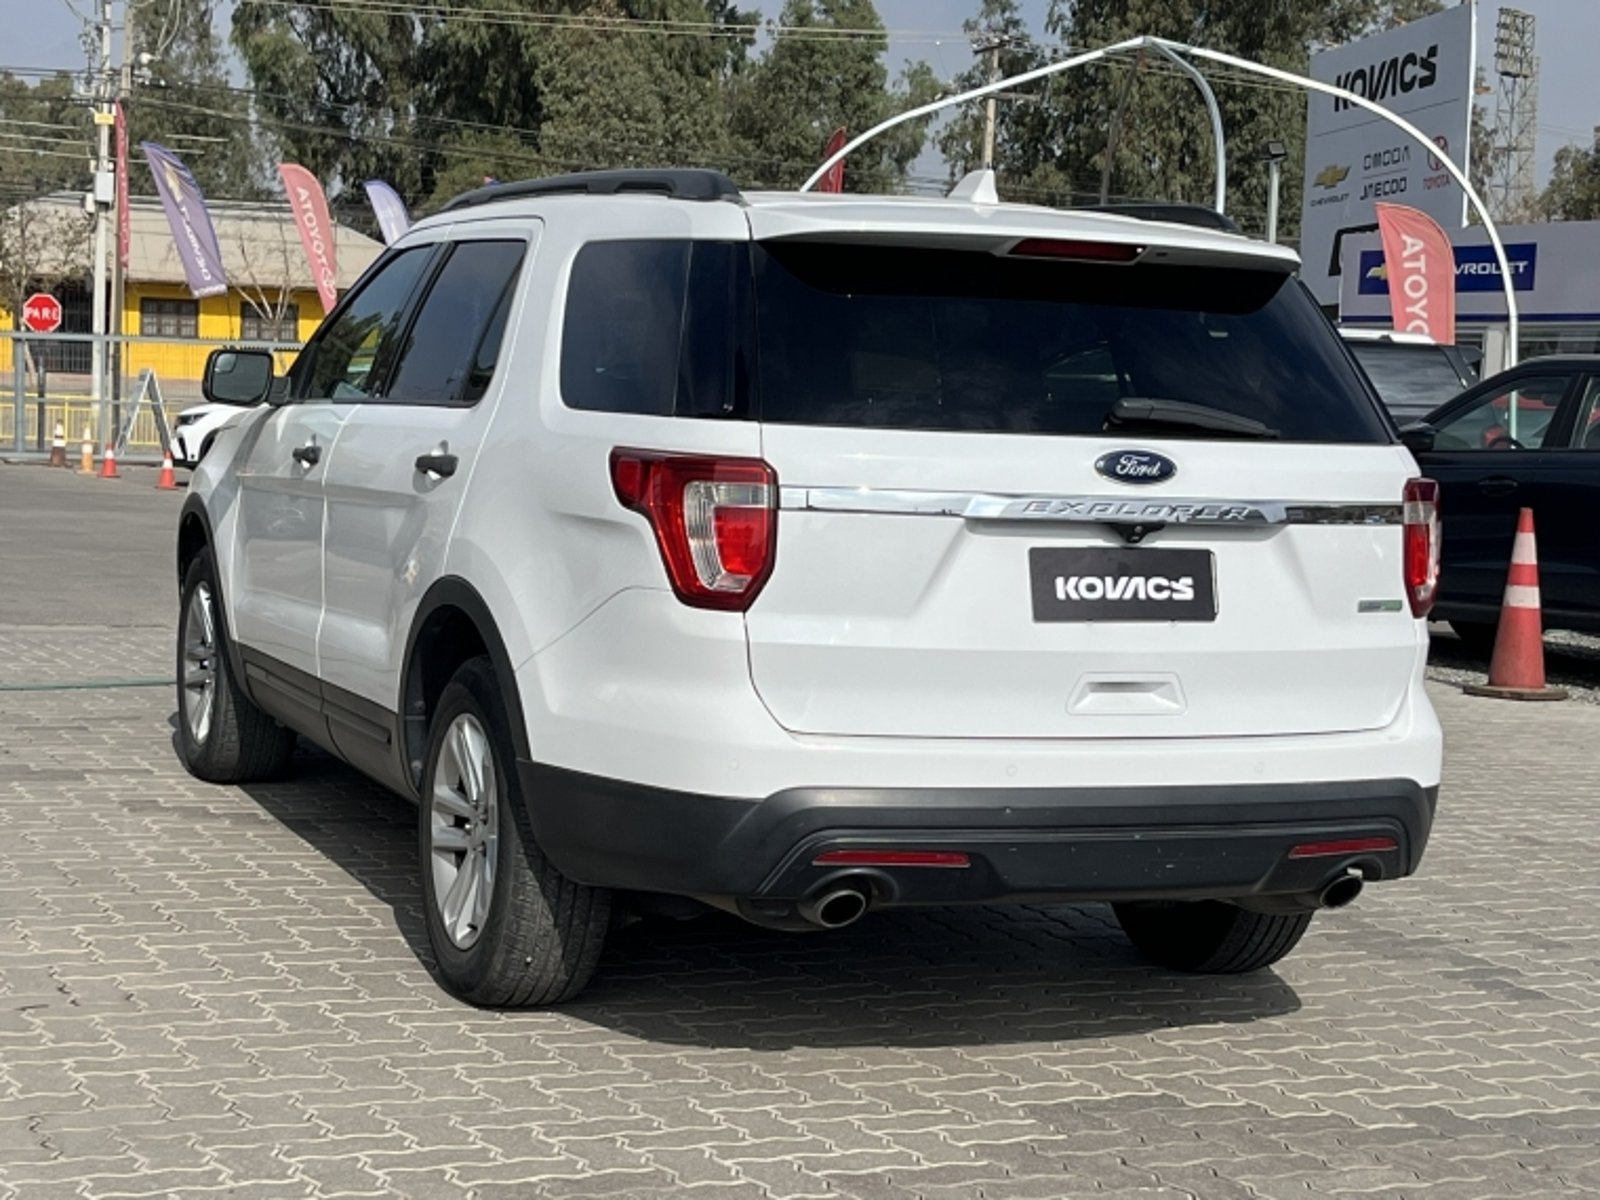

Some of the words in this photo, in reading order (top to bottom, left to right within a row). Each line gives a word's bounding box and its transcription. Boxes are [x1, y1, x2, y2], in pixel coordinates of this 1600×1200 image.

[1334, 44, 1438, 112] KOVACS
[25, 306, 58, 320] PARE
[1115, 454, 1162, 476] Ford
[1023, 501, 1249, 520] EXPLORER
[1055, 576, 1194, 600] KOVACS
